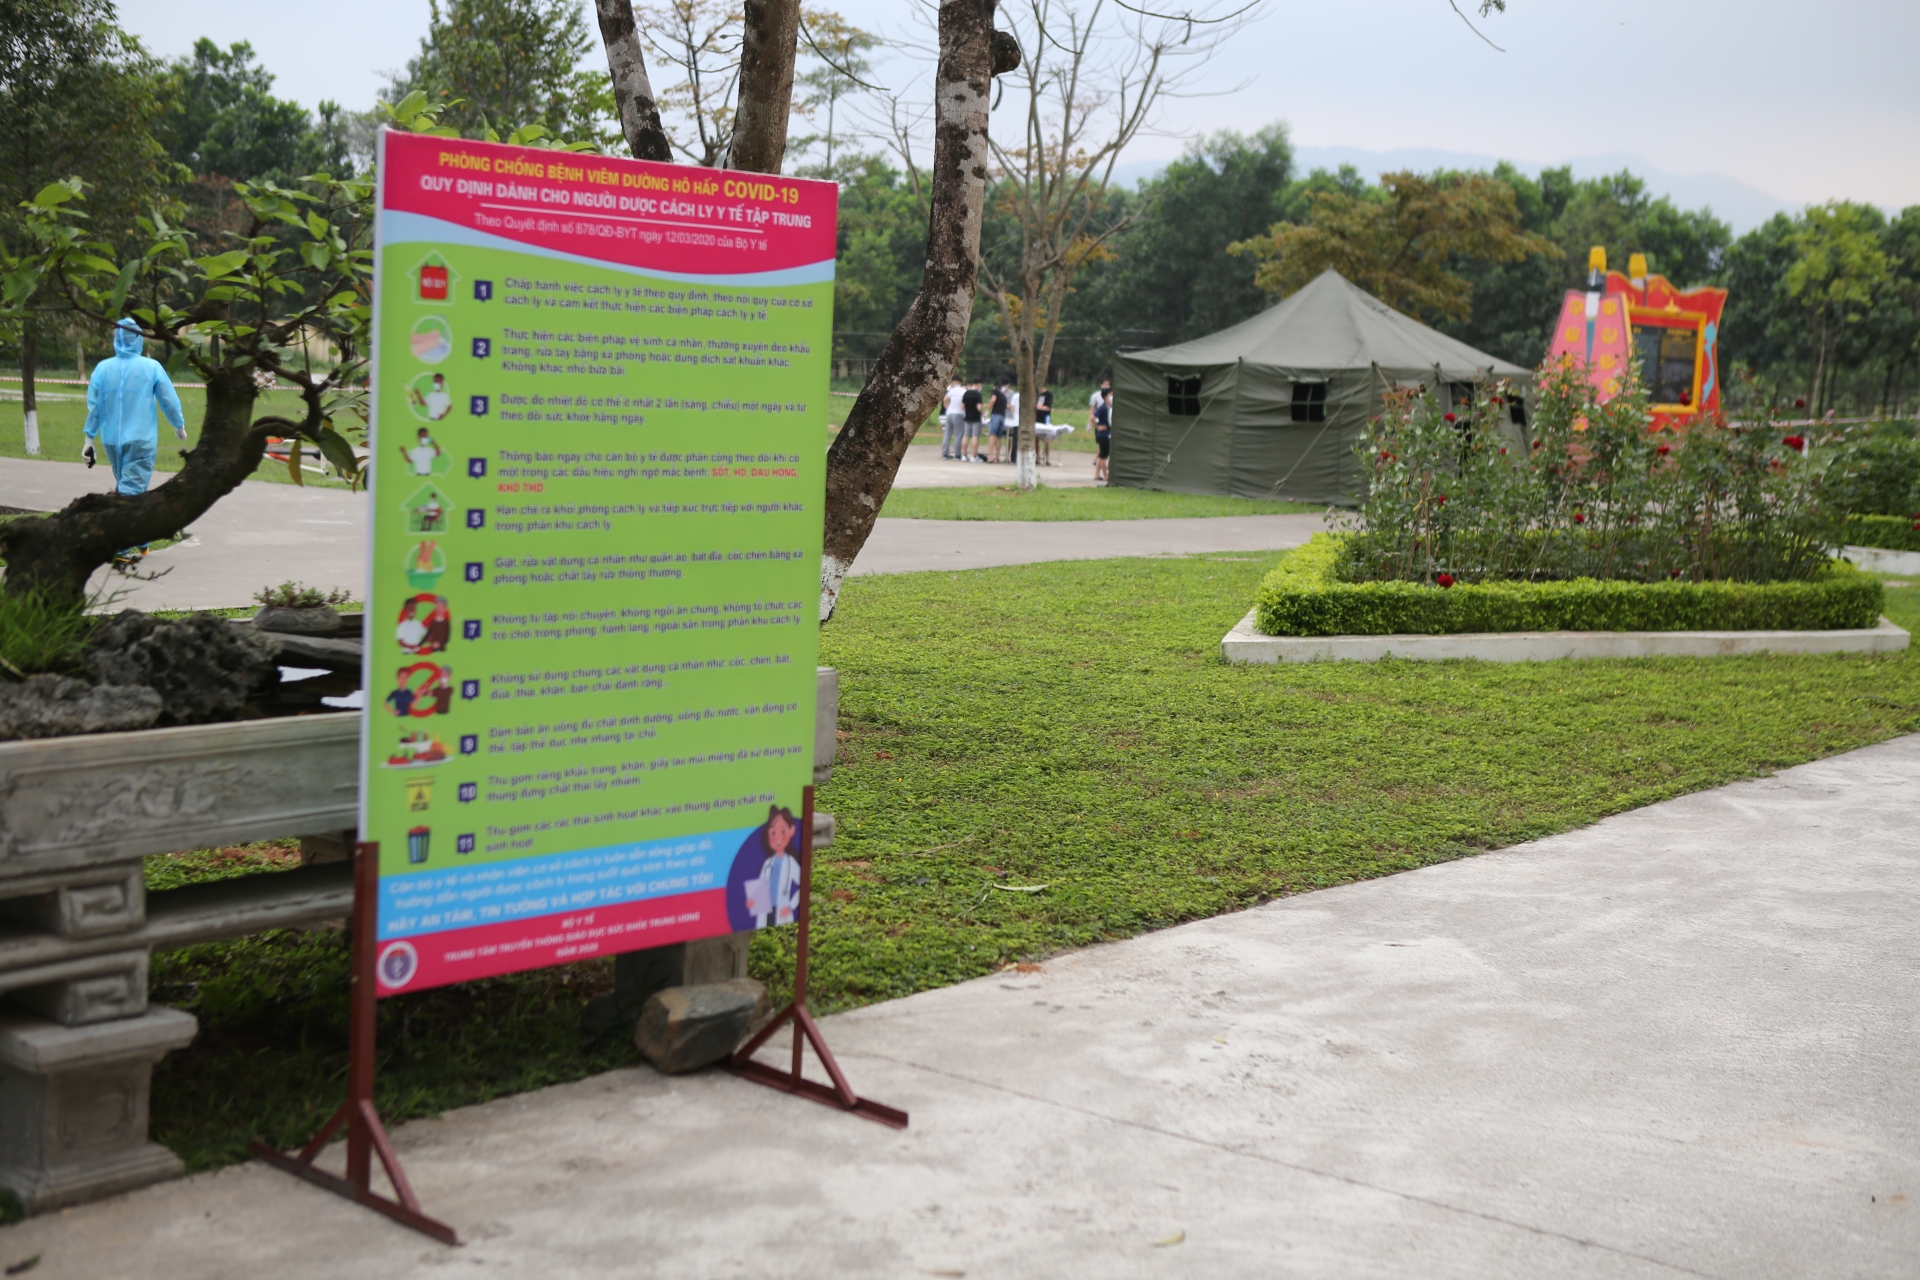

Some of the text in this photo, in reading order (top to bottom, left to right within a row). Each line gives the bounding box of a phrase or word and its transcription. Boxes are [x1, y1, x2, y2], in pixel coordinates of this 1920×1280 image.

[439, 151, 799, 204] PHÒNG CHỐNG BỆNH VIÊM ĐƯỜNG HÔ HẤP COVID-19
[420, 175, 811, 228] QUY ĐỊNH DÀNH CHO NGƯỜI ĐƯỢC CÁCH LY Y TẾ TẬP TRUNG
[475, 212, 768, 251] Theo Quyết định số 878/QĐ-BYT ngày 12/03/2020 của Bộ Y tế
[480, 284, 486, 297] 1
[477, 341, 486, 355] 2
[475, 399, 484, 412] 3
[472, 462, 482, 473] 4
[472, 512, 480, 525] 5
[469, 566, 479, 579] 6
[468, 623, 477, 636] 7
[466, 683, 475, 696] 8
[464, 738, 474, 751] 9
[461, 786, 475, 798] 10
[460, 838, 472, 849] 11
